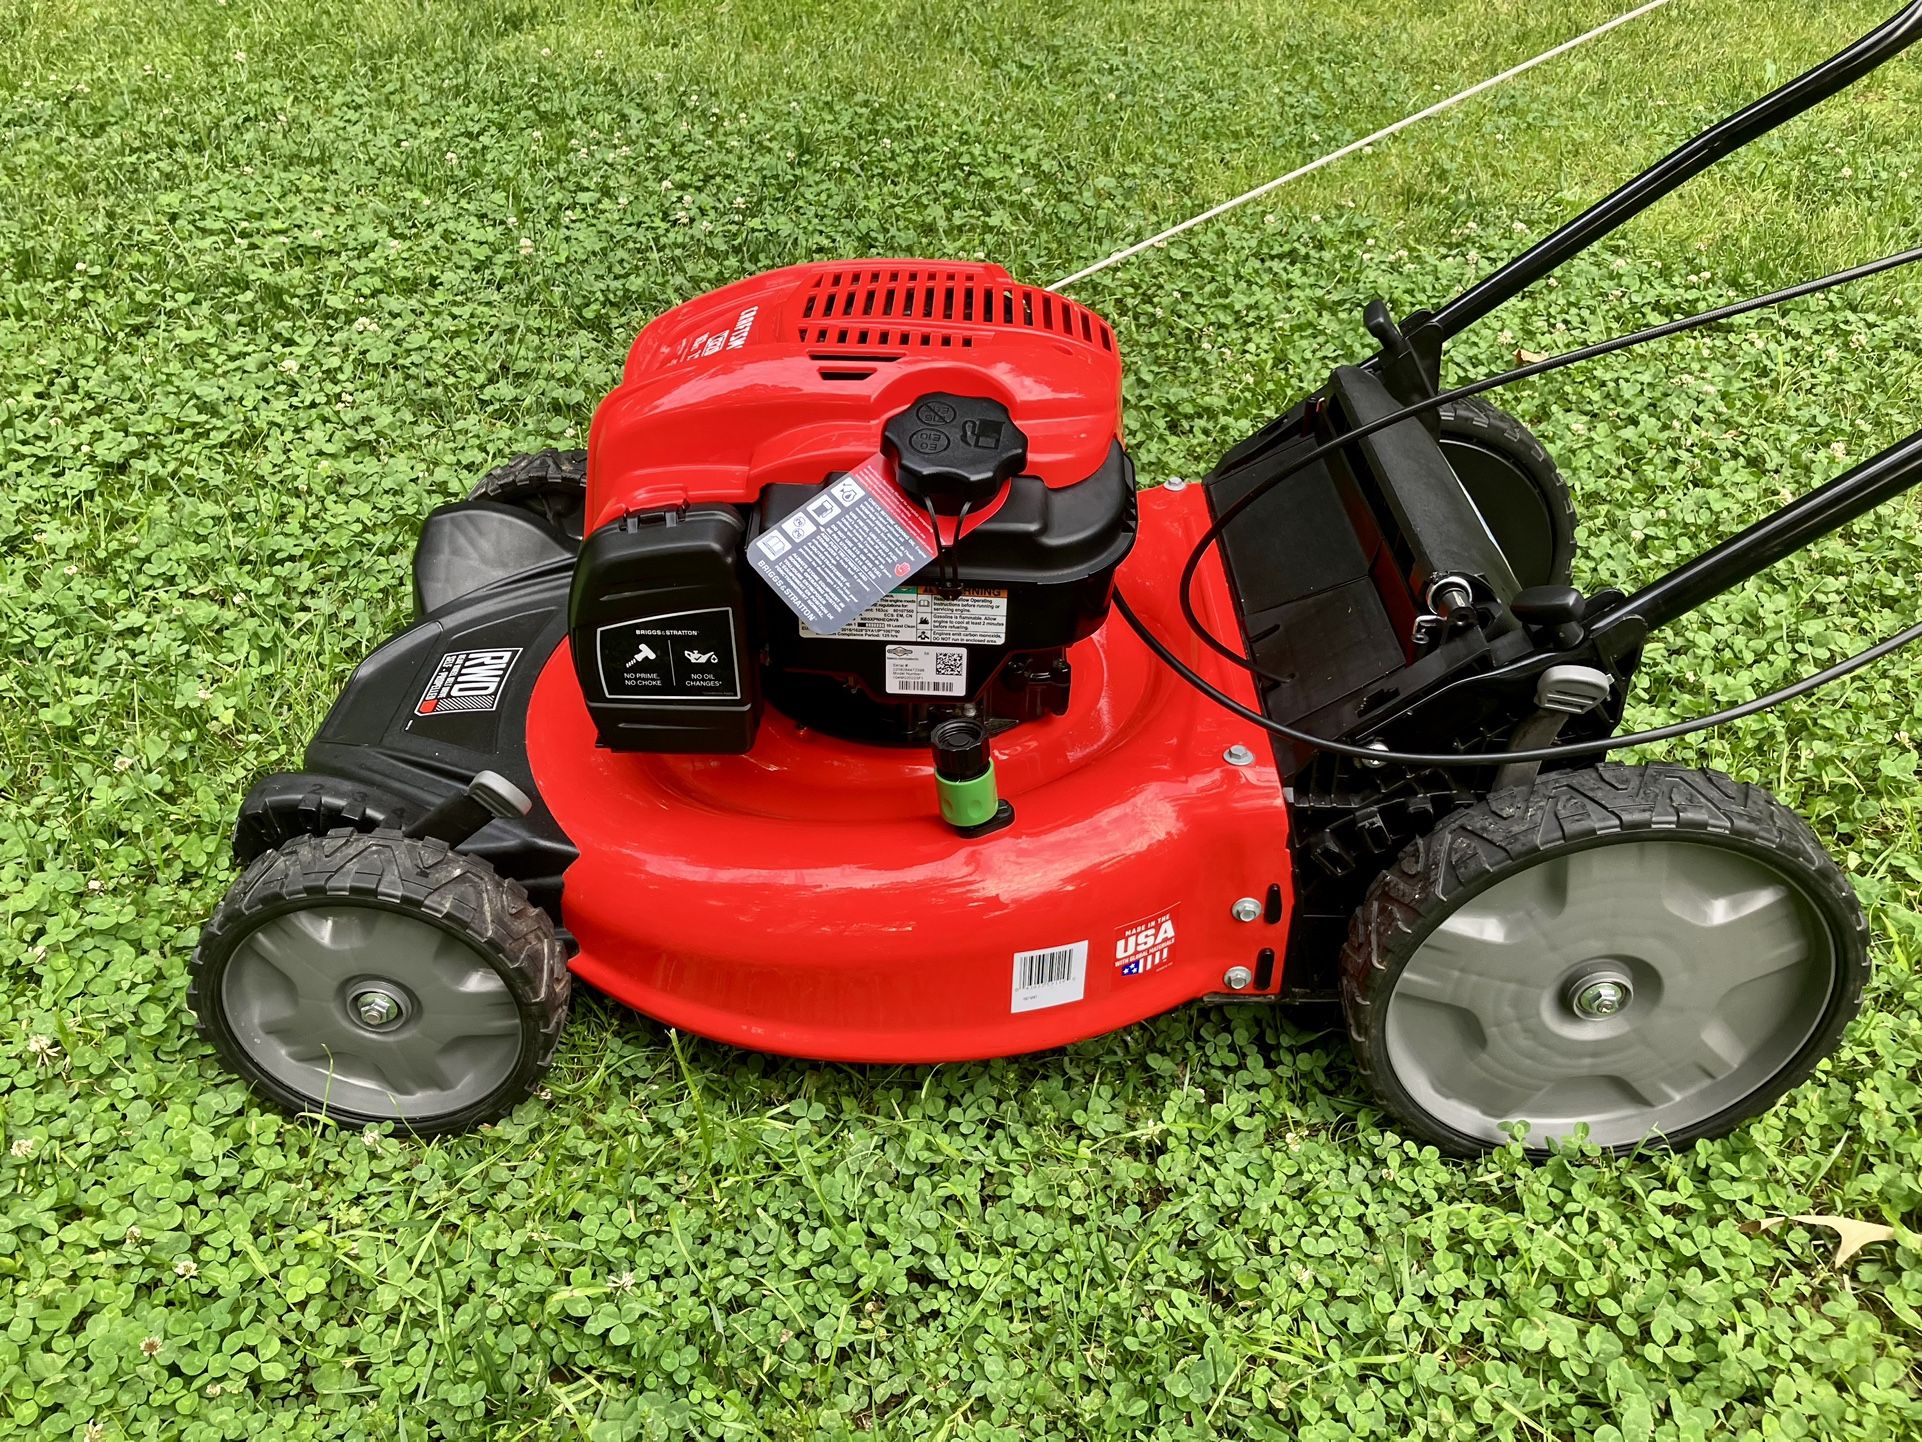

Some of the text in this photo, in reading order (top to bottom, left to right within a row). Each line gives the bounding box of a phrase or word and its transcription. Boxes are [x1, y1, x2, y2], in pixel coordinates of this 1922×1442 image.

[836, 530, 846, 539] NOT
[450, 652, 512, 697] RWD
[1125, 913, 1170, 937] MADE IN THE
[1116, 919, 1175, 959] USA
[1115, 957, 1129, 967] WITH
